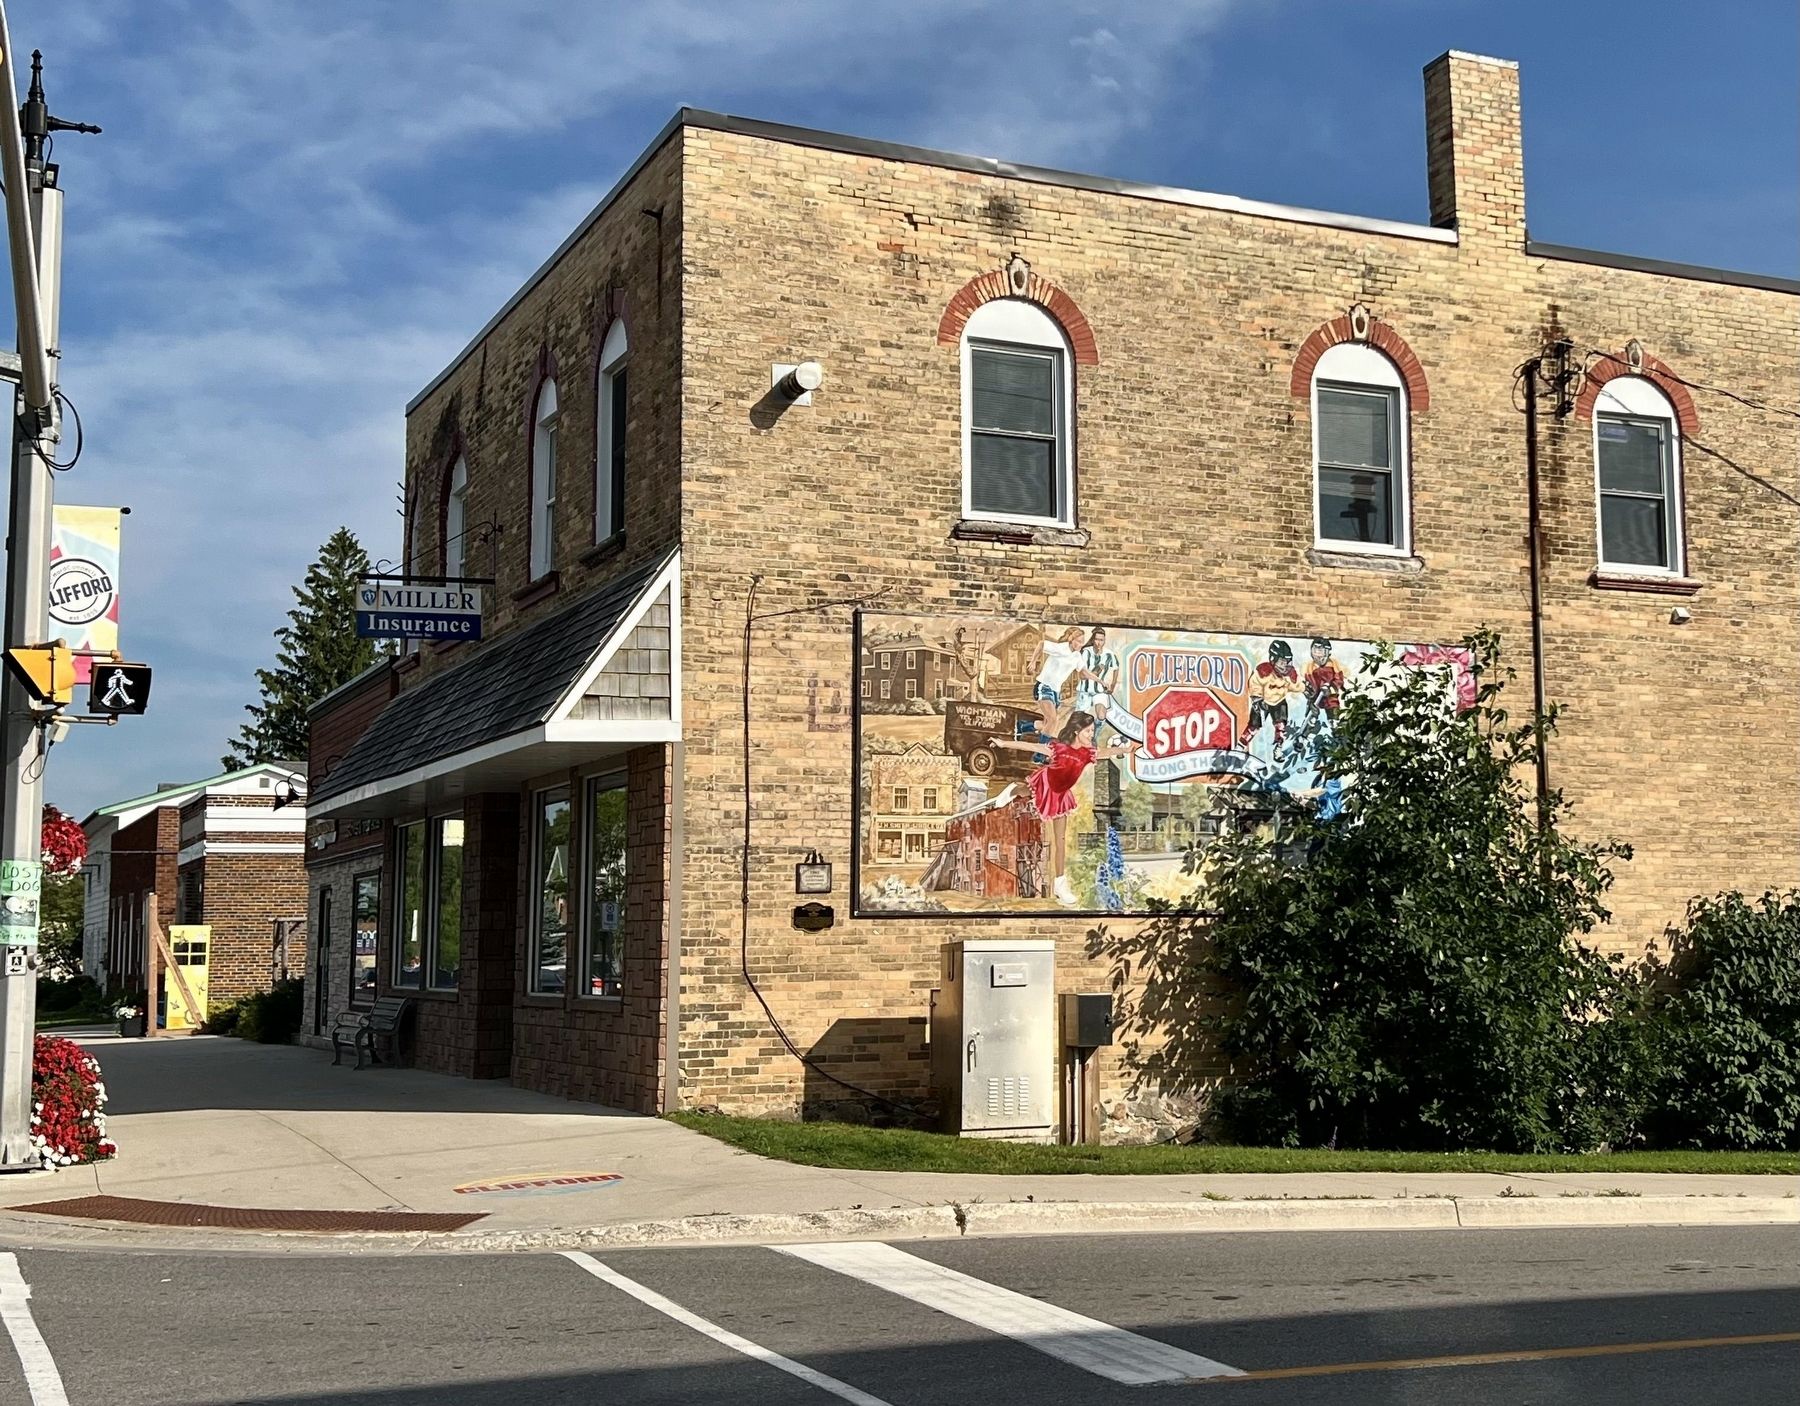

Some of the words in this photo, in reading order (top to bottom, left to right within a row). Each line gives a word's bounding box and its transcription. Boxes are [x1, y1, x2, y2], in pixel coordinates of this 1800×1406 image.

[49, 576, 113, 607] LIFFORD
[381, 590, 475, 610] MILLER
[368, 614, 470, 633] Insurance
[1133, 652, 1245, 695] CLIFFORD
[955, 705, 1007, 719] WIGHTMAN
[1112, 710, 1143, 735] YOUR
[1154, 707, 1221, 756] STOP
[1142, 759, 1187, 776] ALONG
[2, 866, 41, 880] LOST
[10, 881, 40, 892] DOG
[453, 1174, 625, 1194] CLIFFORD
